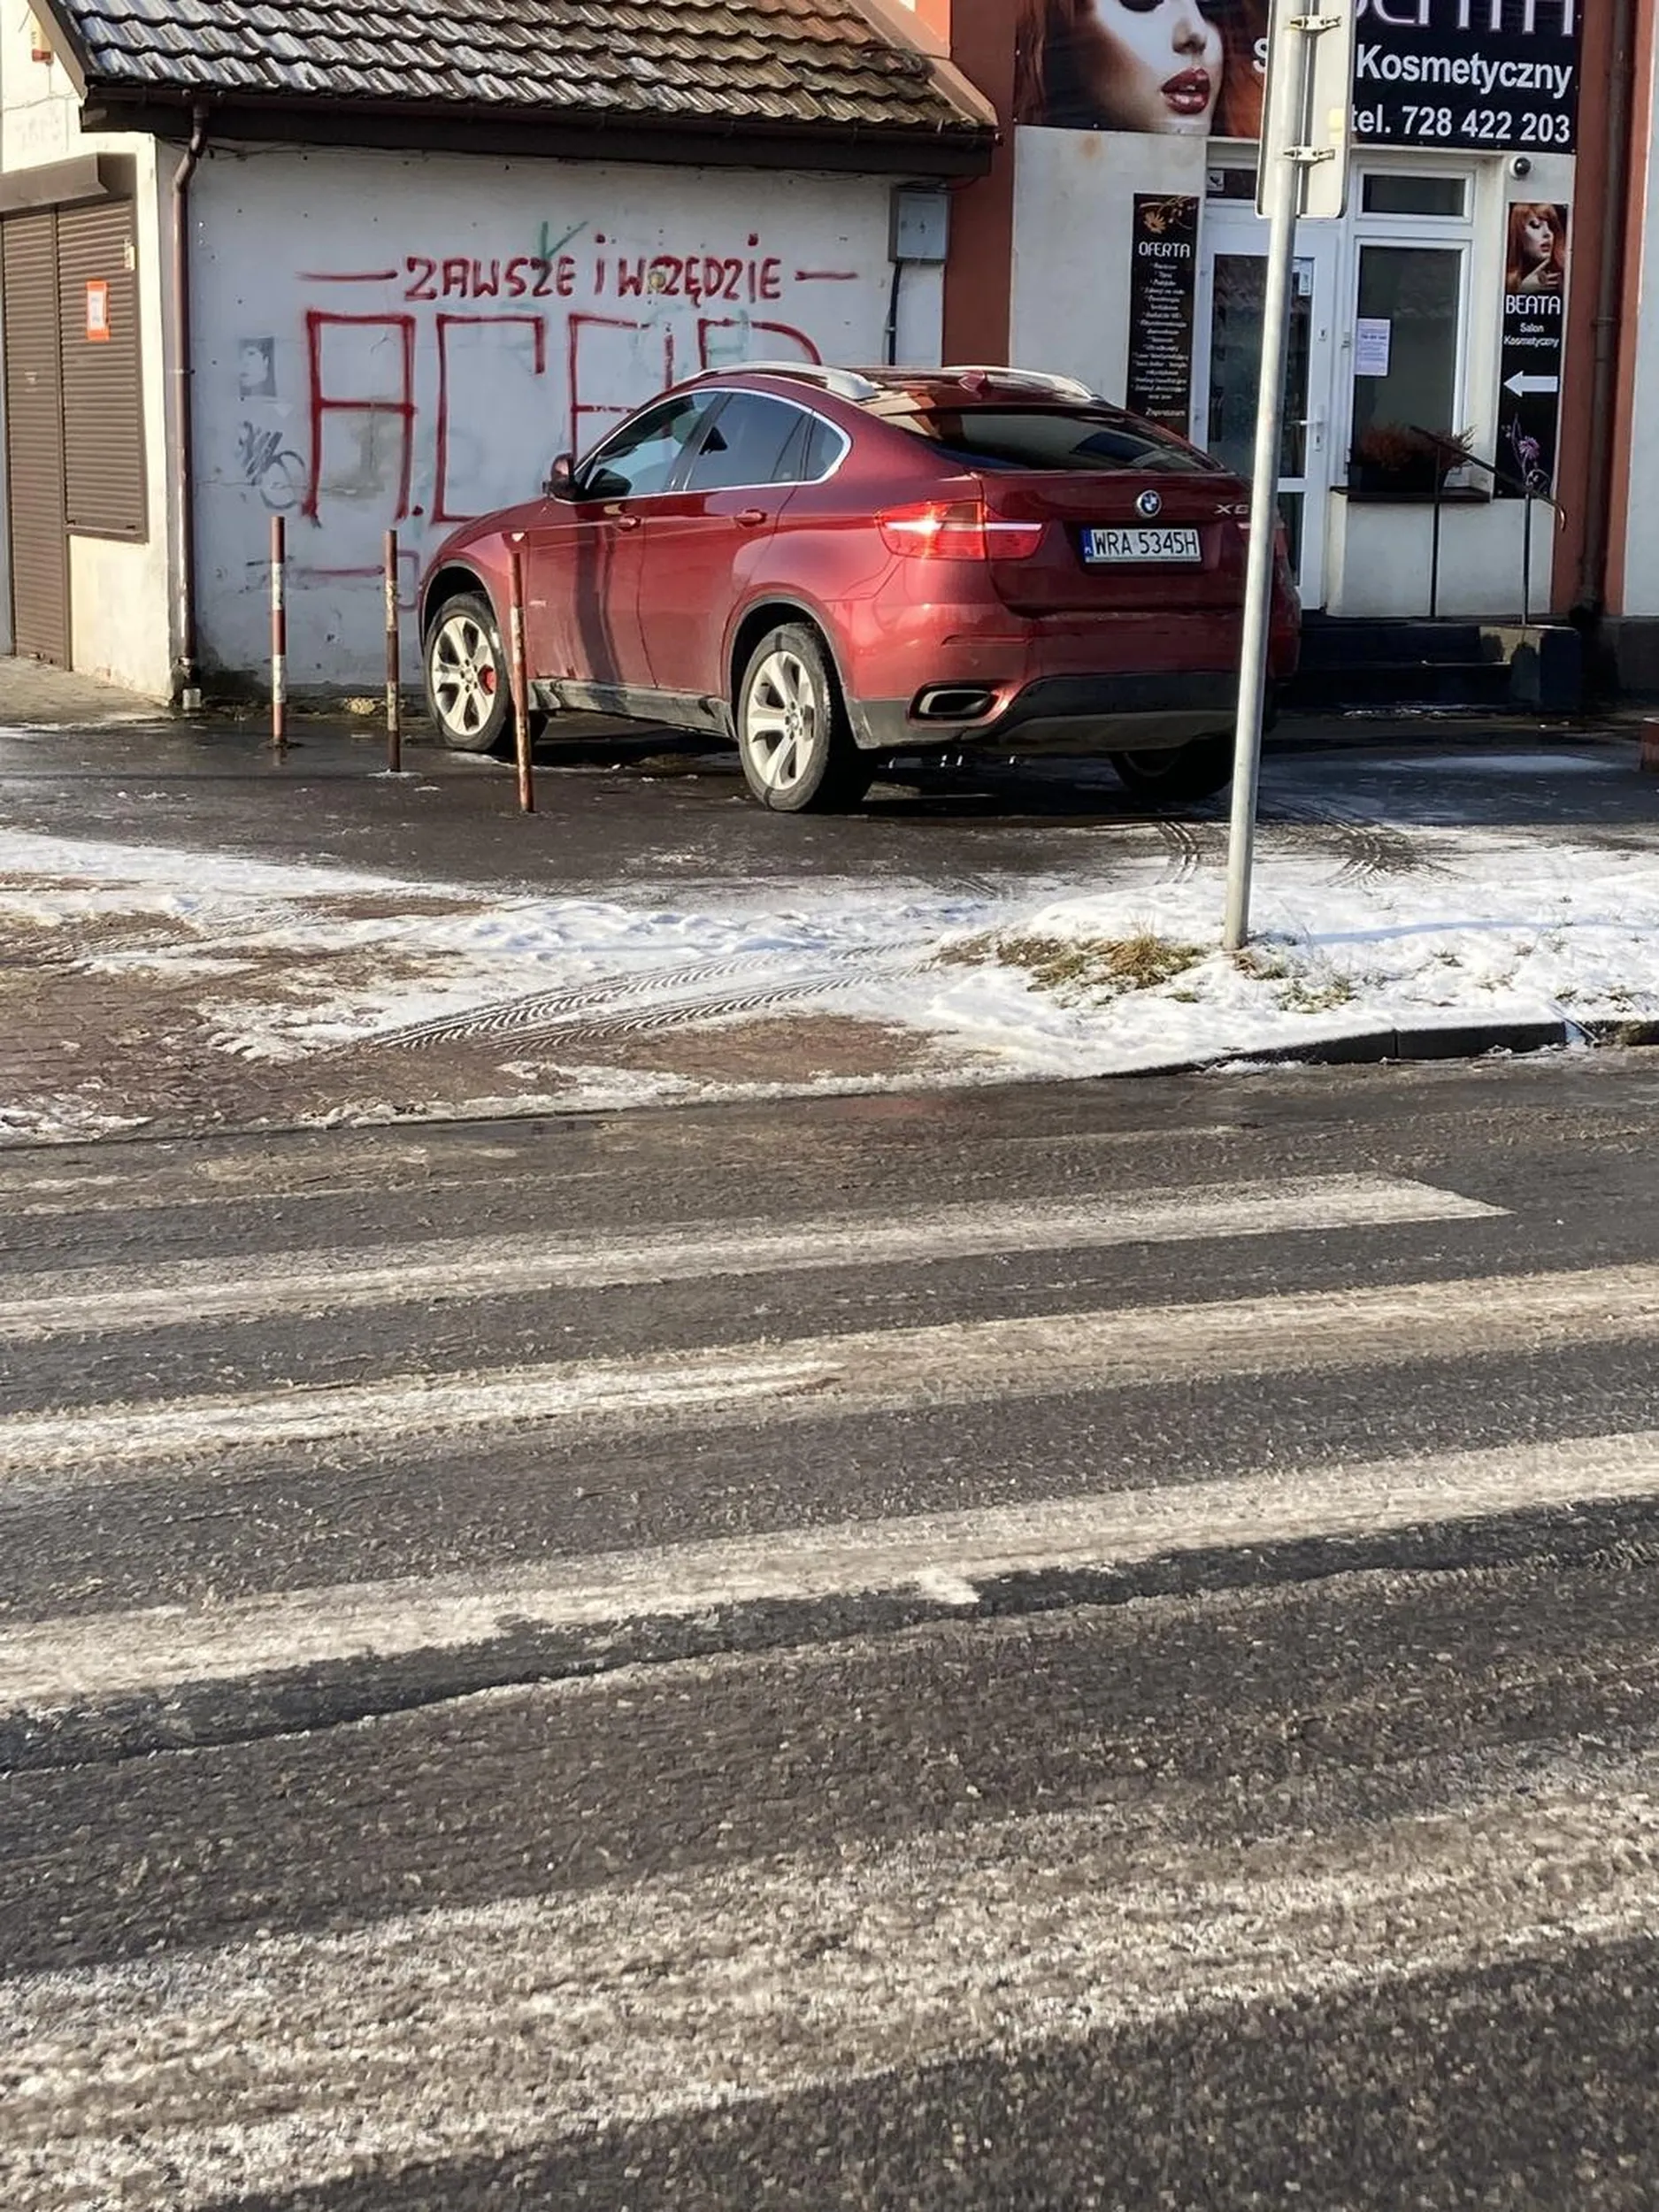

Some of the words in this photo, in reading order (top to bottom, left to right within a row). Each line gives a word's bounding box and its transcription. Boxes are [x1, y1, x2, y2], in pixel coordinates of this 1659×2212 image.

[1356, 44, 1573, 99] Kosmetyczny
[1351, 104, 1392, 134] tel.
[1402, 105, 1453, 136] 728
[1461, 109, 1512, 141] 422
[1519, 112, 1571, 143] 203
[1139, 241, 1191, 257] OFERTA
[404, 256, 576, 301] ZAWSZE
[1506, 295, 1561, 315] BEATA
[1519, 322, 1545, 333] Salon
[1094, 531, 1133, 556] WRA
[1138, 532, 1198, 556] 5345H
